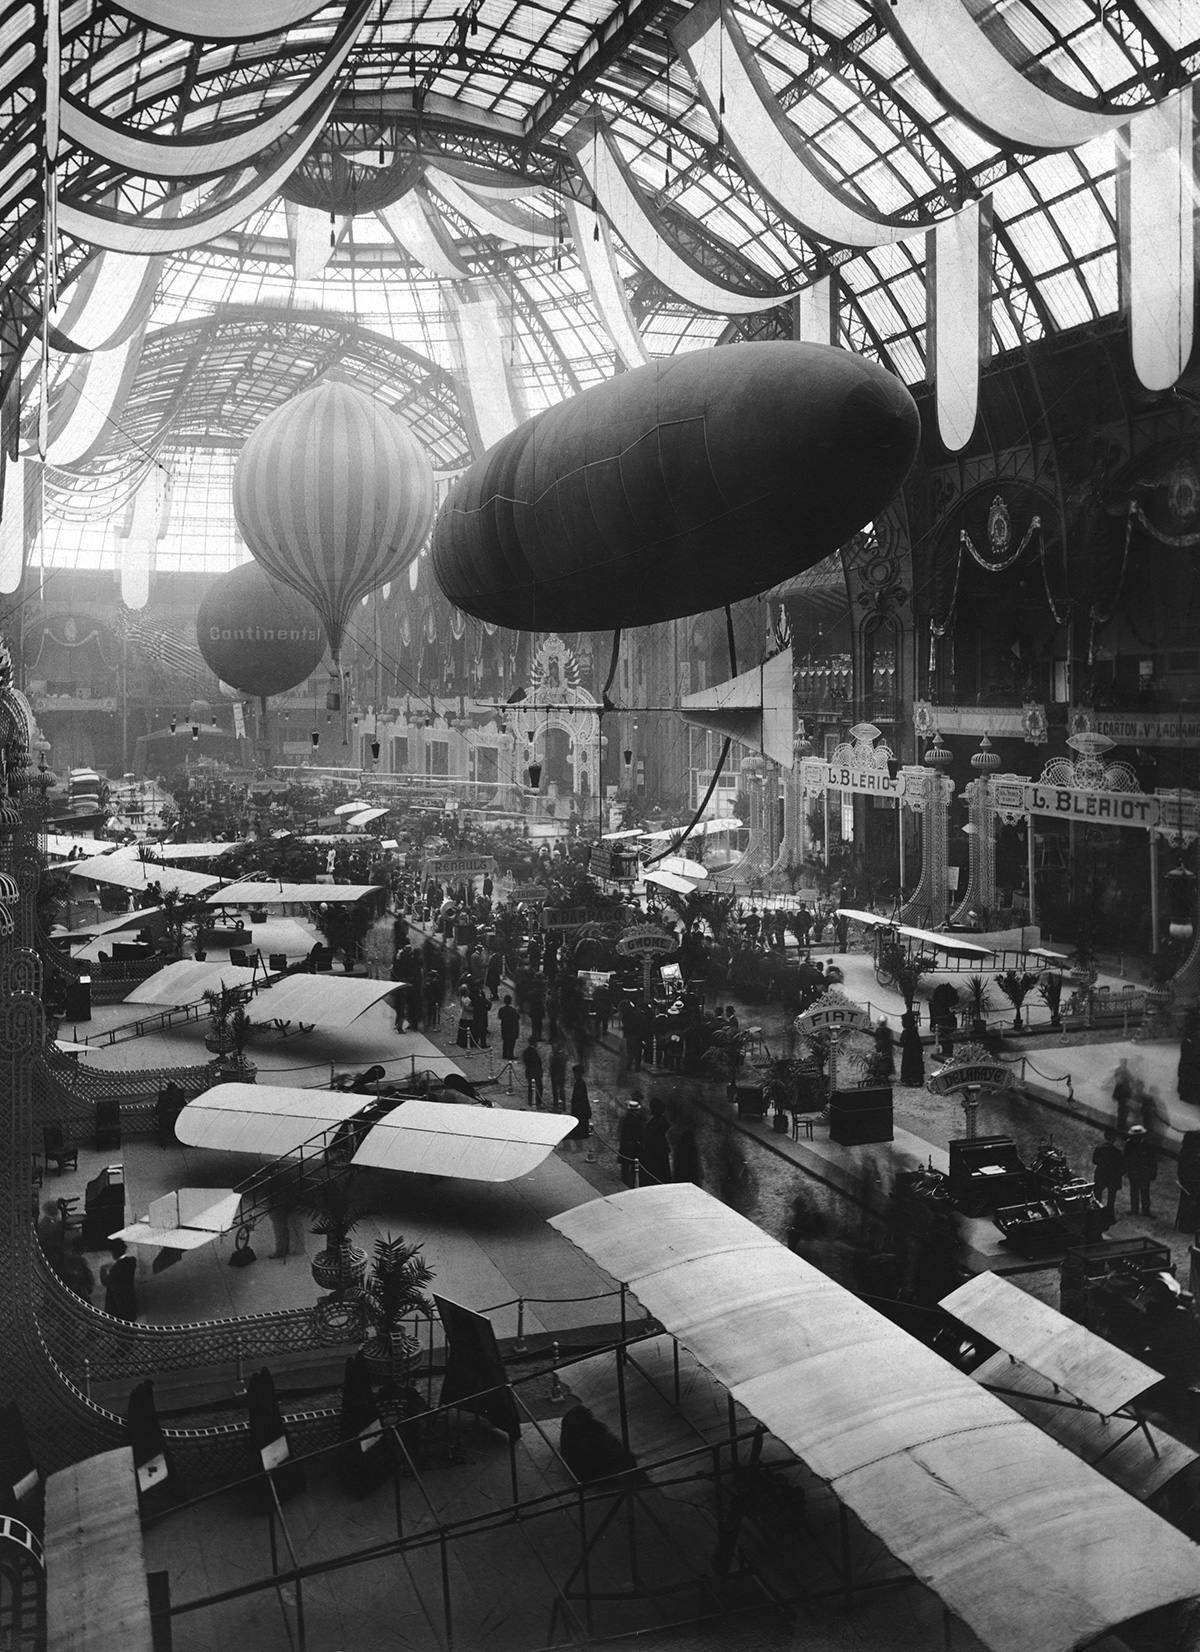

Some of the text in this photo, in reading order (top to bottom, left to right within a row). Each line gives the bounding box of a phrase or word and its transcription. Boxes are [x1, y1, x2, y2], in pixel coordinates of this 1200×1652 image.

[209, 625, 321, 641] Continental
[1055, 789, 1151, 821] BLÉRIOT
[434, 861, 487, 873] RENAULT
[811, 1009, 859, 1027] FIAT
[944, 1067, 1003, 1087] DELAHAYE
